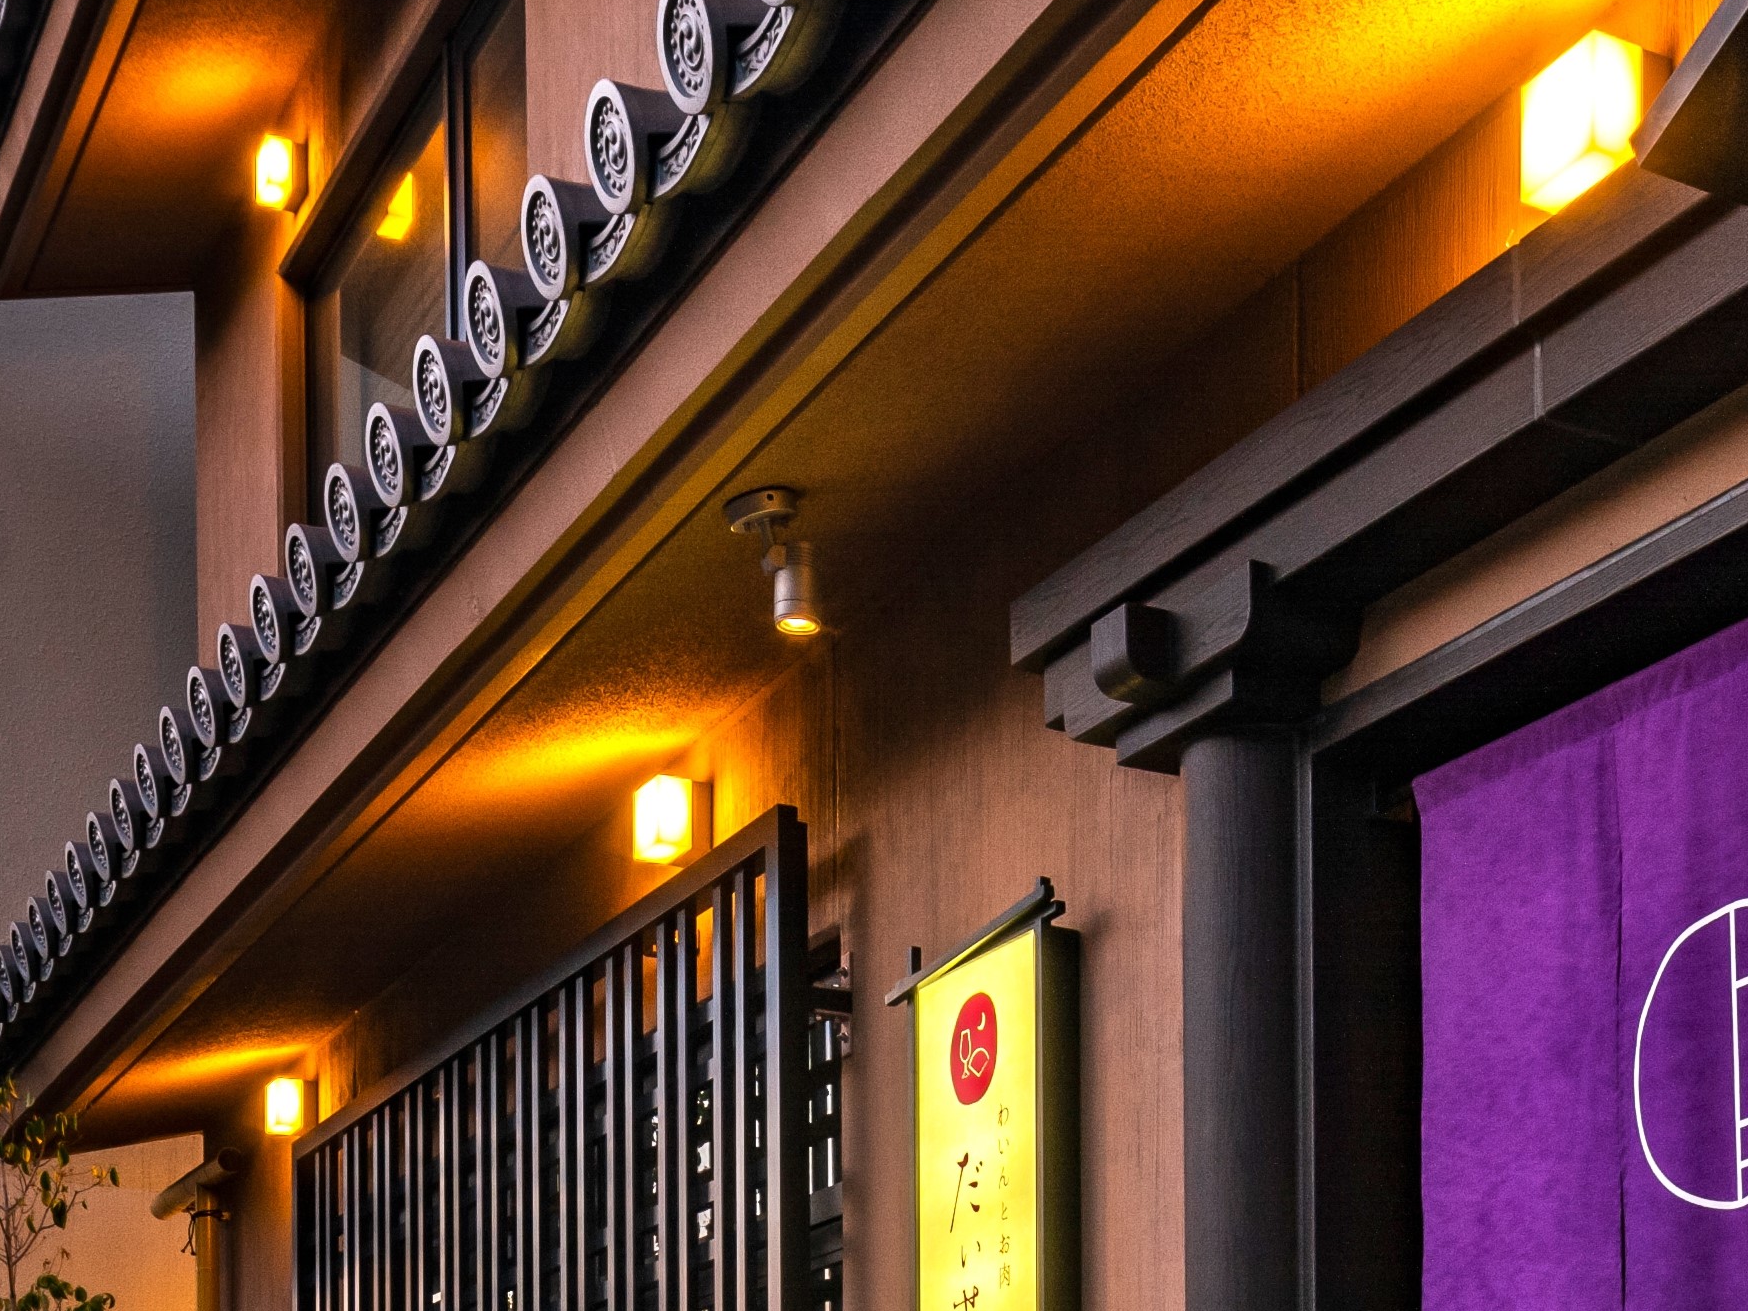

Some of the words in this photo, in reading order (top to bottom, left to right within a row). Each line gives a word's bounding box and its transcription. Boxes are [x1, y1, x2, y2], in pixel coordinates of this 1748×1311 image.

[997, 1103, 1011, 1289] わいんとお肉
